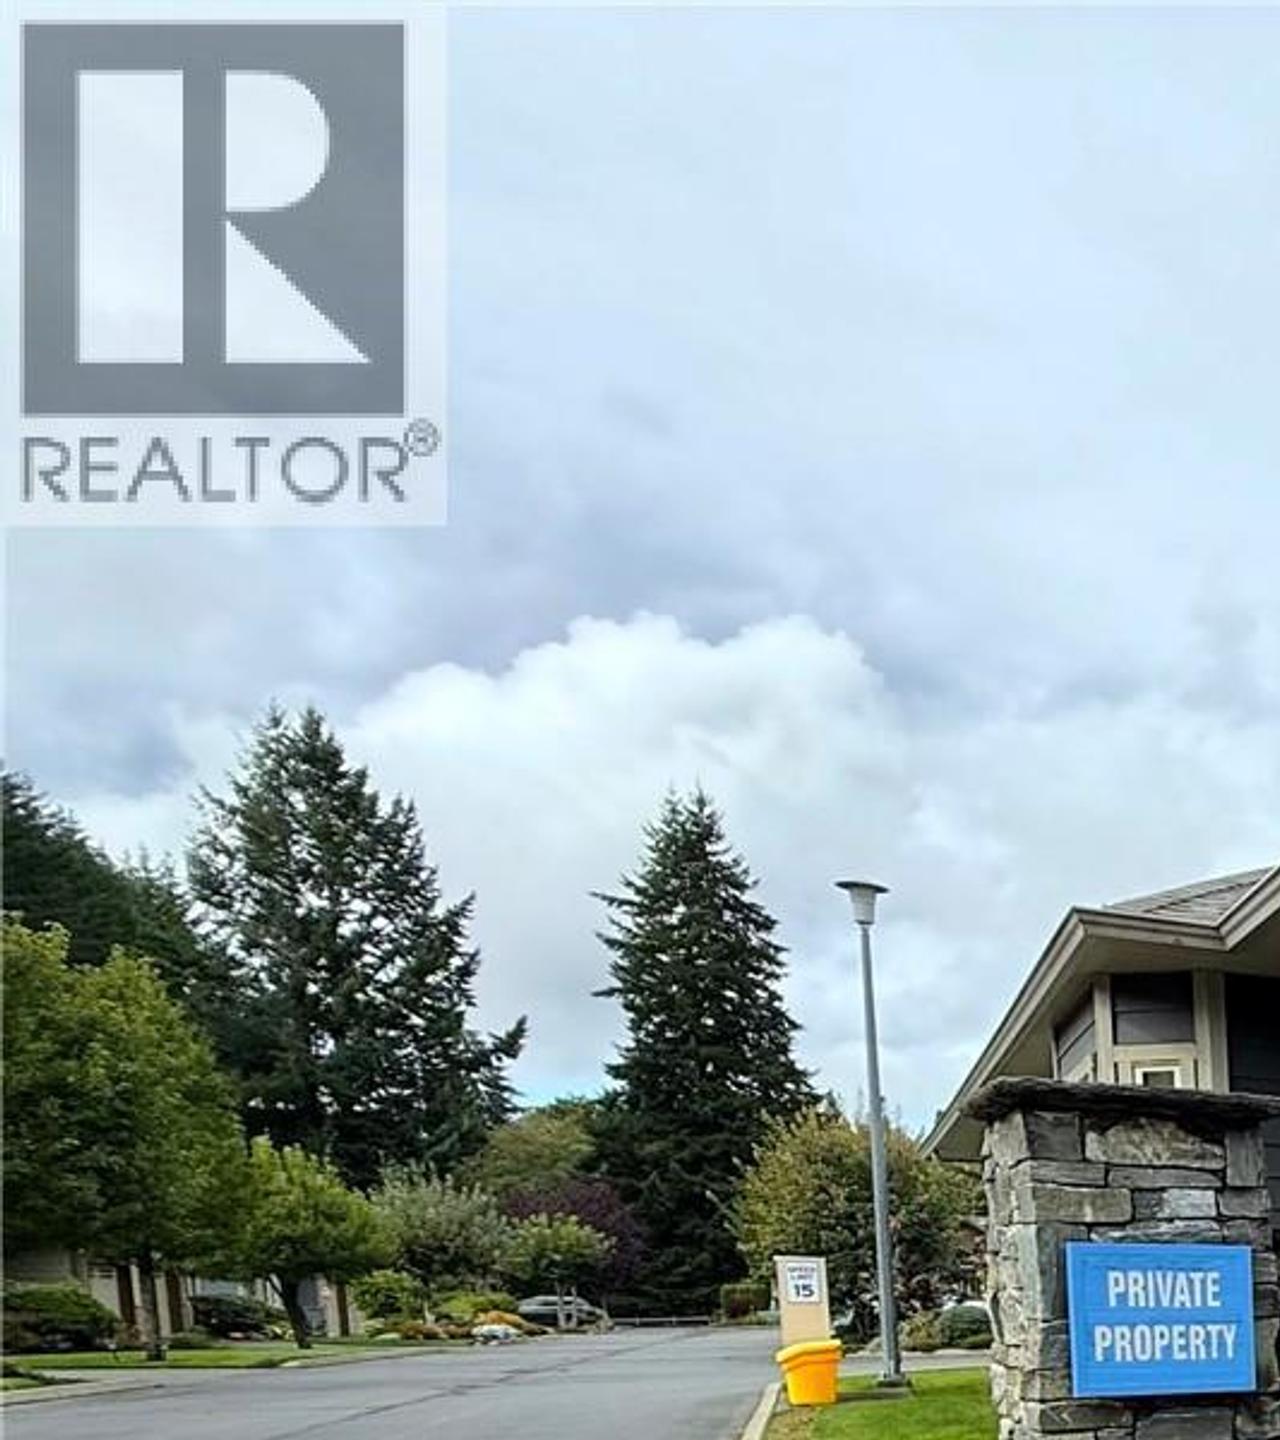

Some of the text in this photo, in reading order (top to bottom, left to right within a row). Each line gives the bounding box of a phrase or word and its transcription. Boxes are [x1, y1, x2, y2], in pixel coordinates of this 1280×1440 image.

[794, 1283, 815, 1298] 15
[1107, 1269, 1221, 1308] PRIVATE
[1094, 1323, 1237, 1362] PROPERTY
